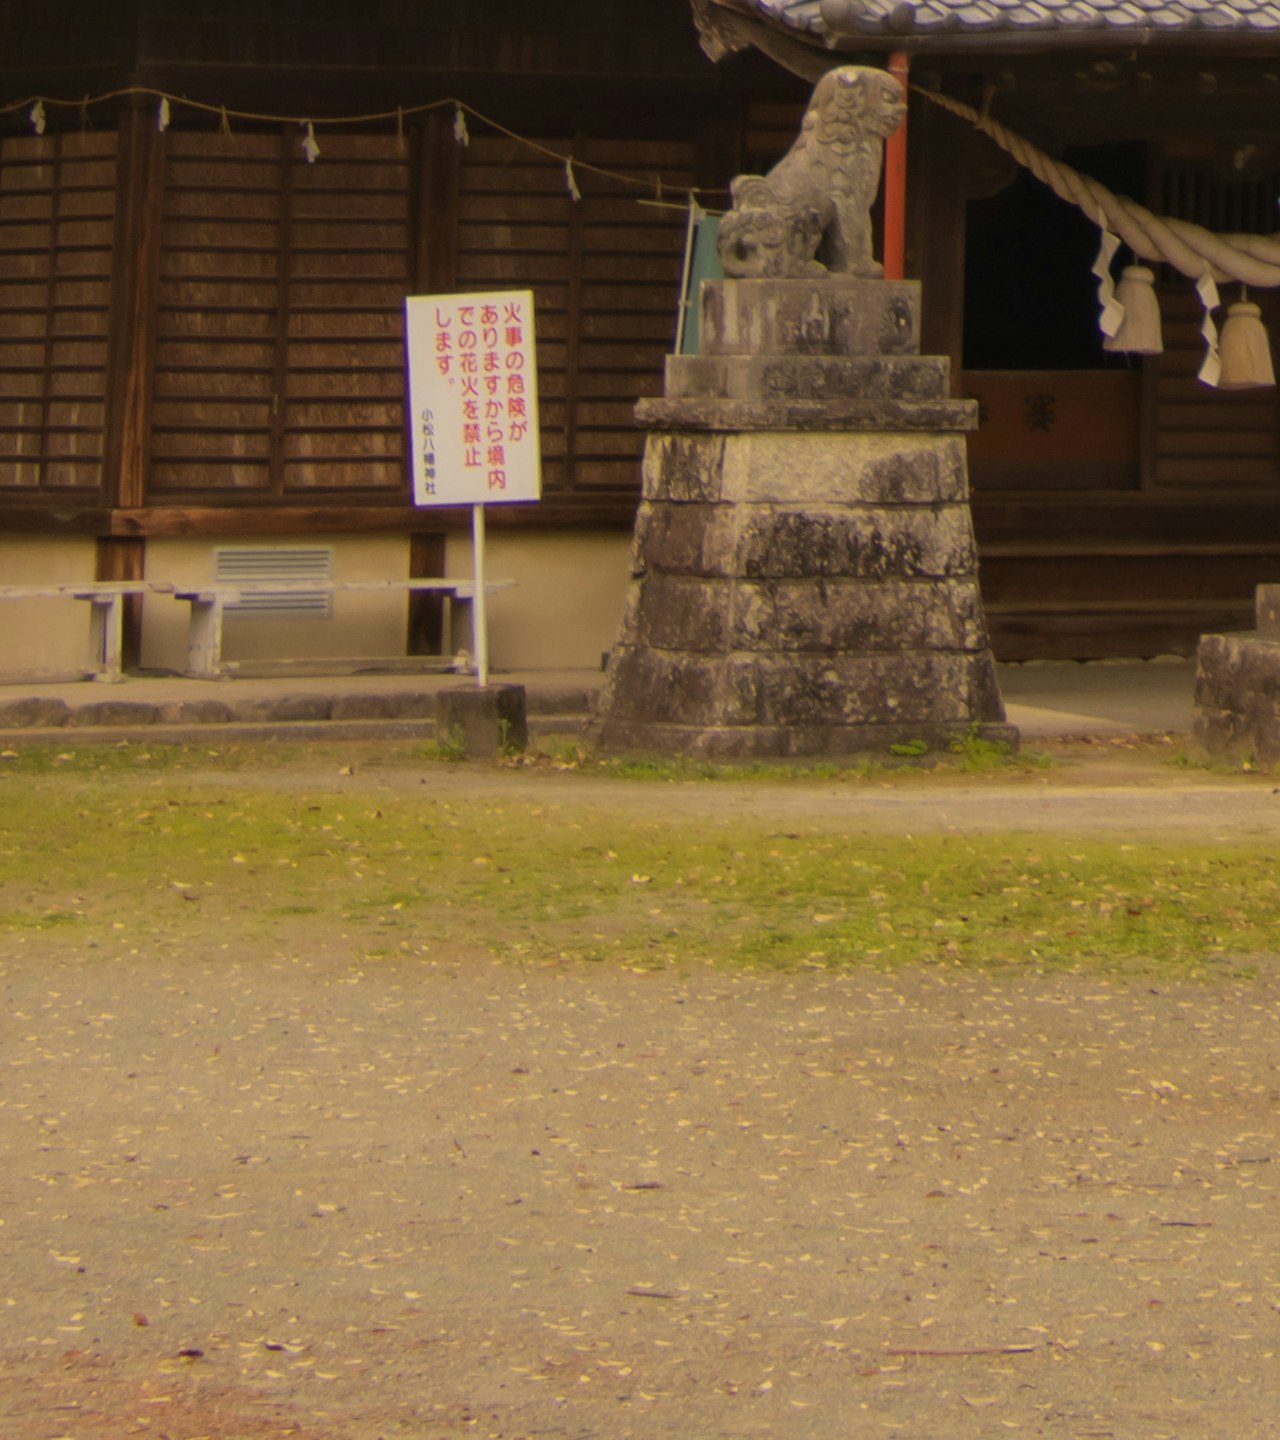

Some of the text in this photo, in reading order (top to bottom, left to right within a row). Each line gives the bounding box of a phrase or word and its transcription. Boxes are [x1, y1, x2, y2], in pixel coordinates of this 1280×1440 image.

[436, 308, 454, 385] します。
[459, 307, 481, 467] での花火を禁止
[481, 305, 505, 489] ありますから境内
[504, 303, 526, 441] 火事の危険が
